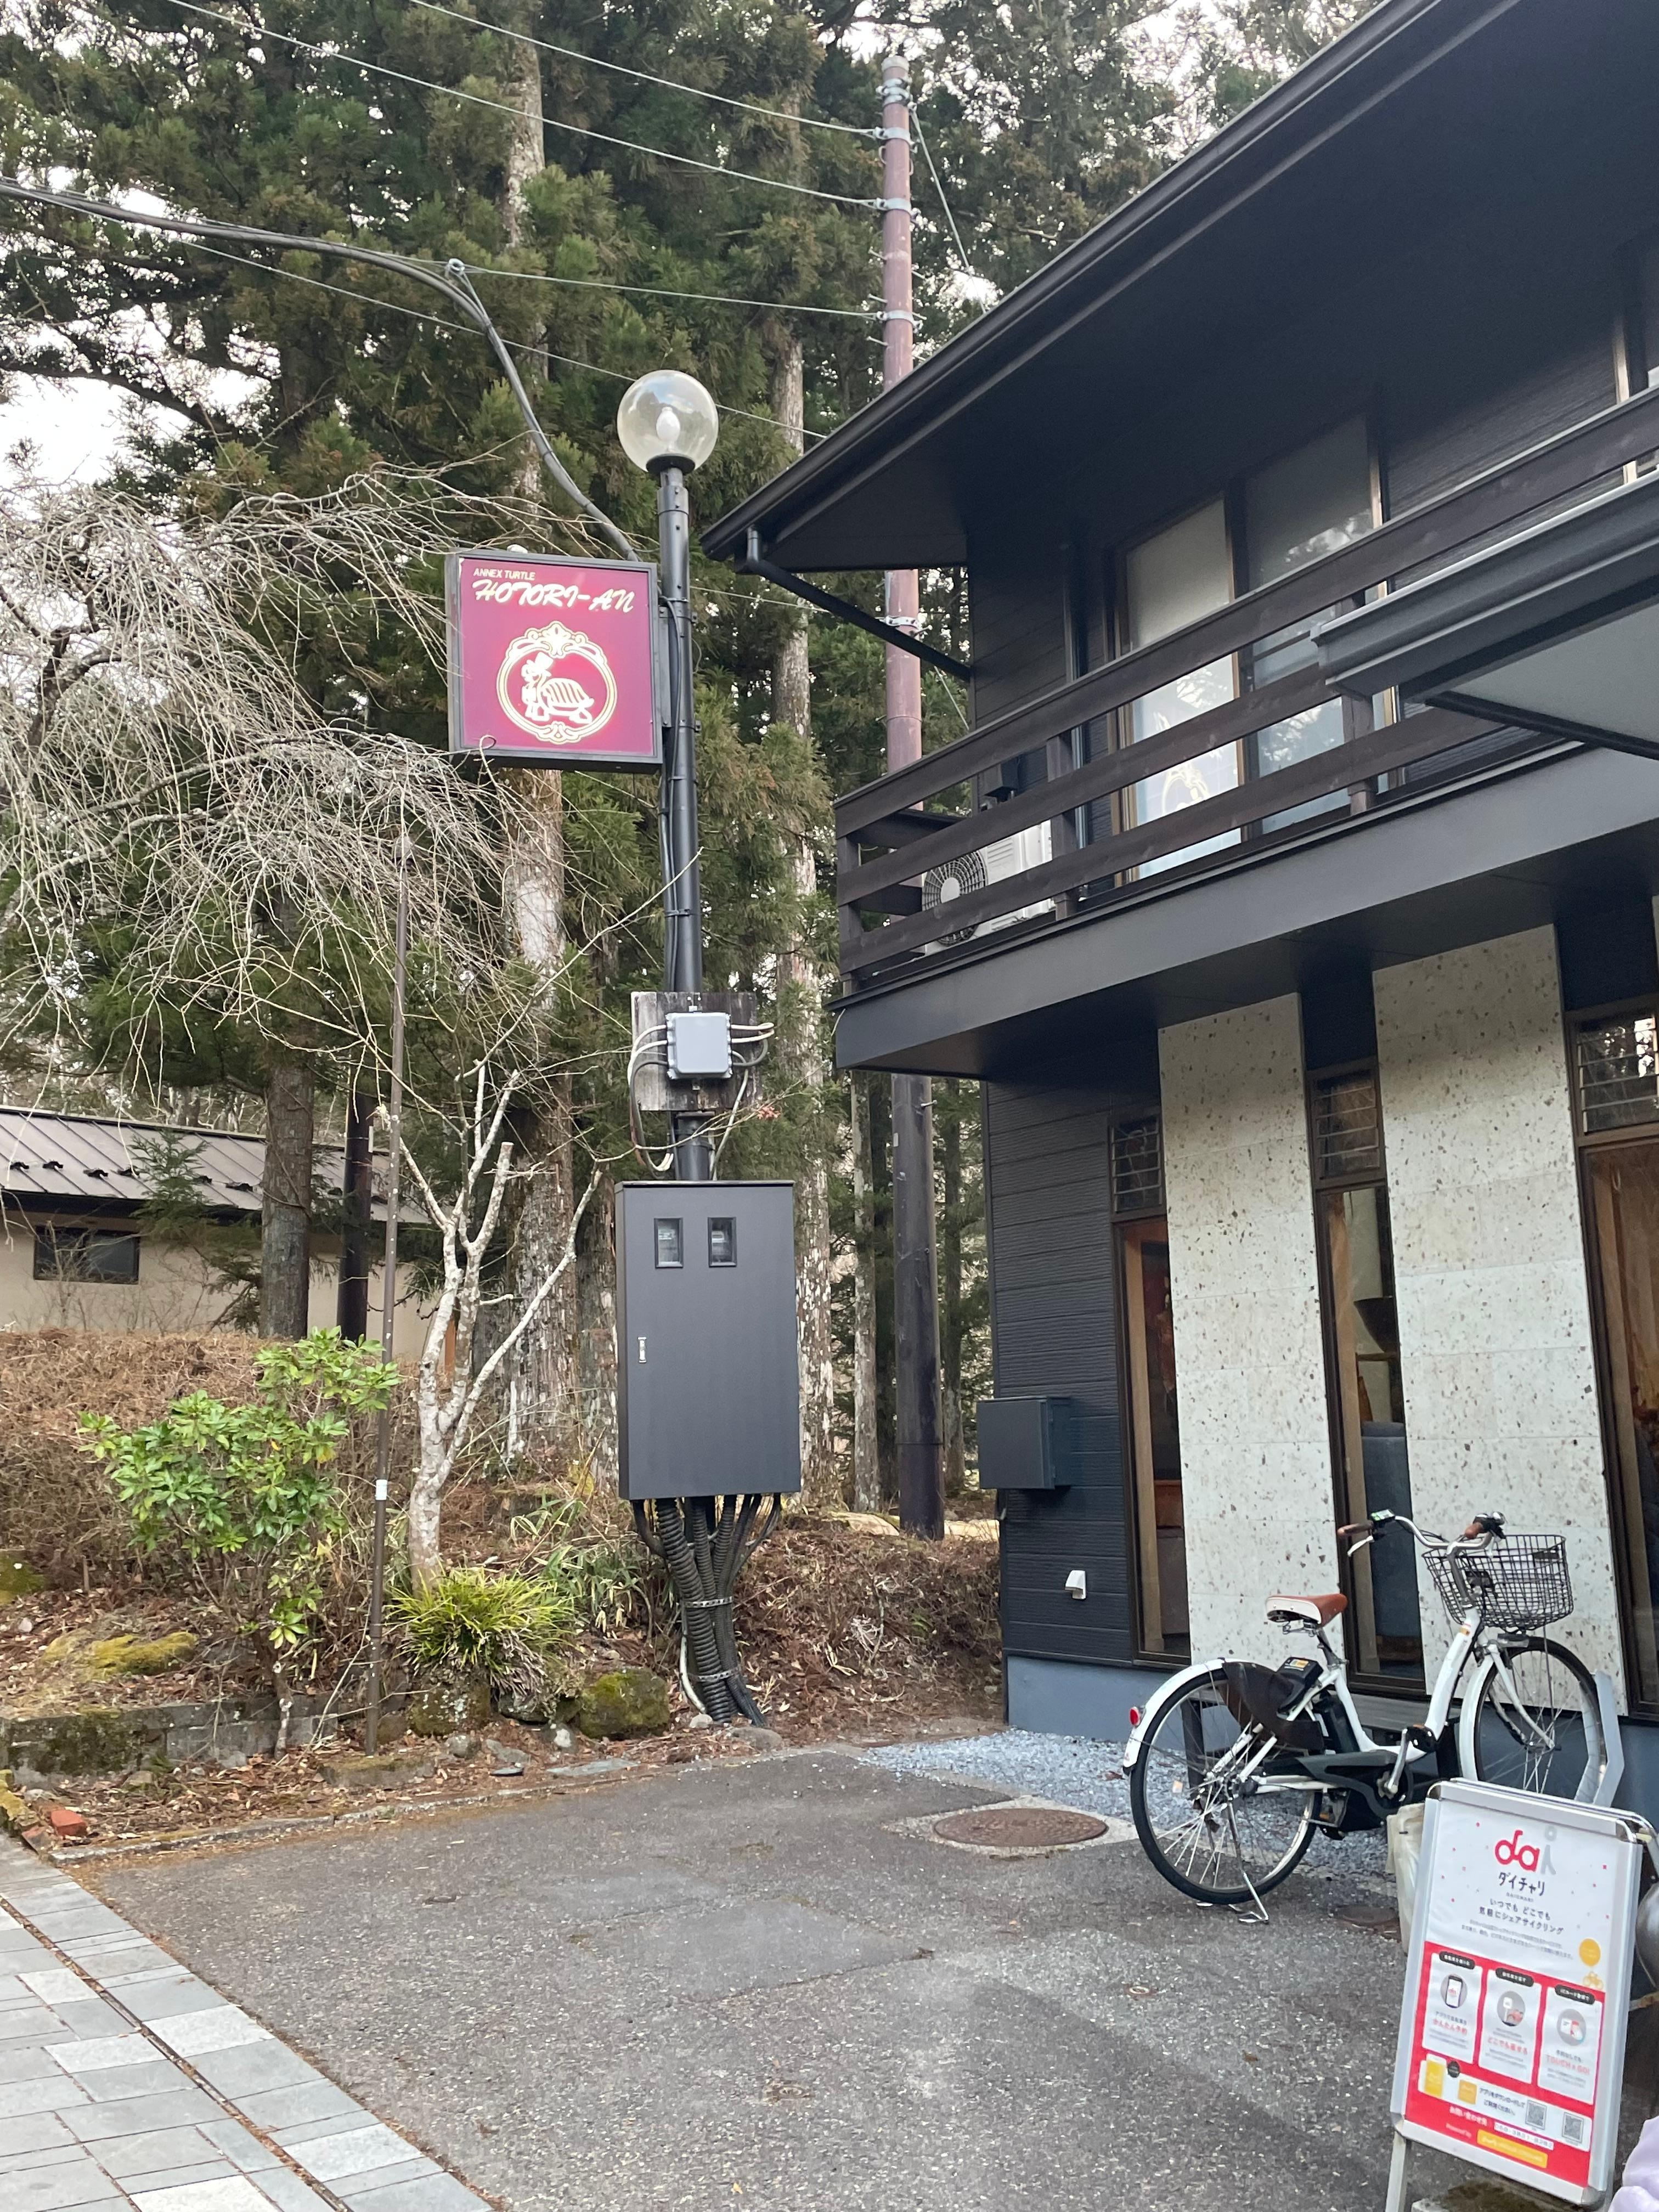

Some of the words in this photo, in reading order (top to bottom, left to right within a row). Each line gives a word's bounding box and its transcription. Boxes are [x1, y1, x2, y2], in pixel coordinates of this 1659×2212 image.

[473, 568, 503, 579] ANNEX
[504, 570, 536, 580] TURTLE
[472, 579, 635, 613] HOTORI-AN
[1499, 1872, 1545, 1896] ダイチャリ
[1479, 1906, 1564, 1935] 気軽にシェアサイクリング
[1490, 1898, 1518, 1912] いつでも
[1523, 1906, 1551, 1921] どこでも
